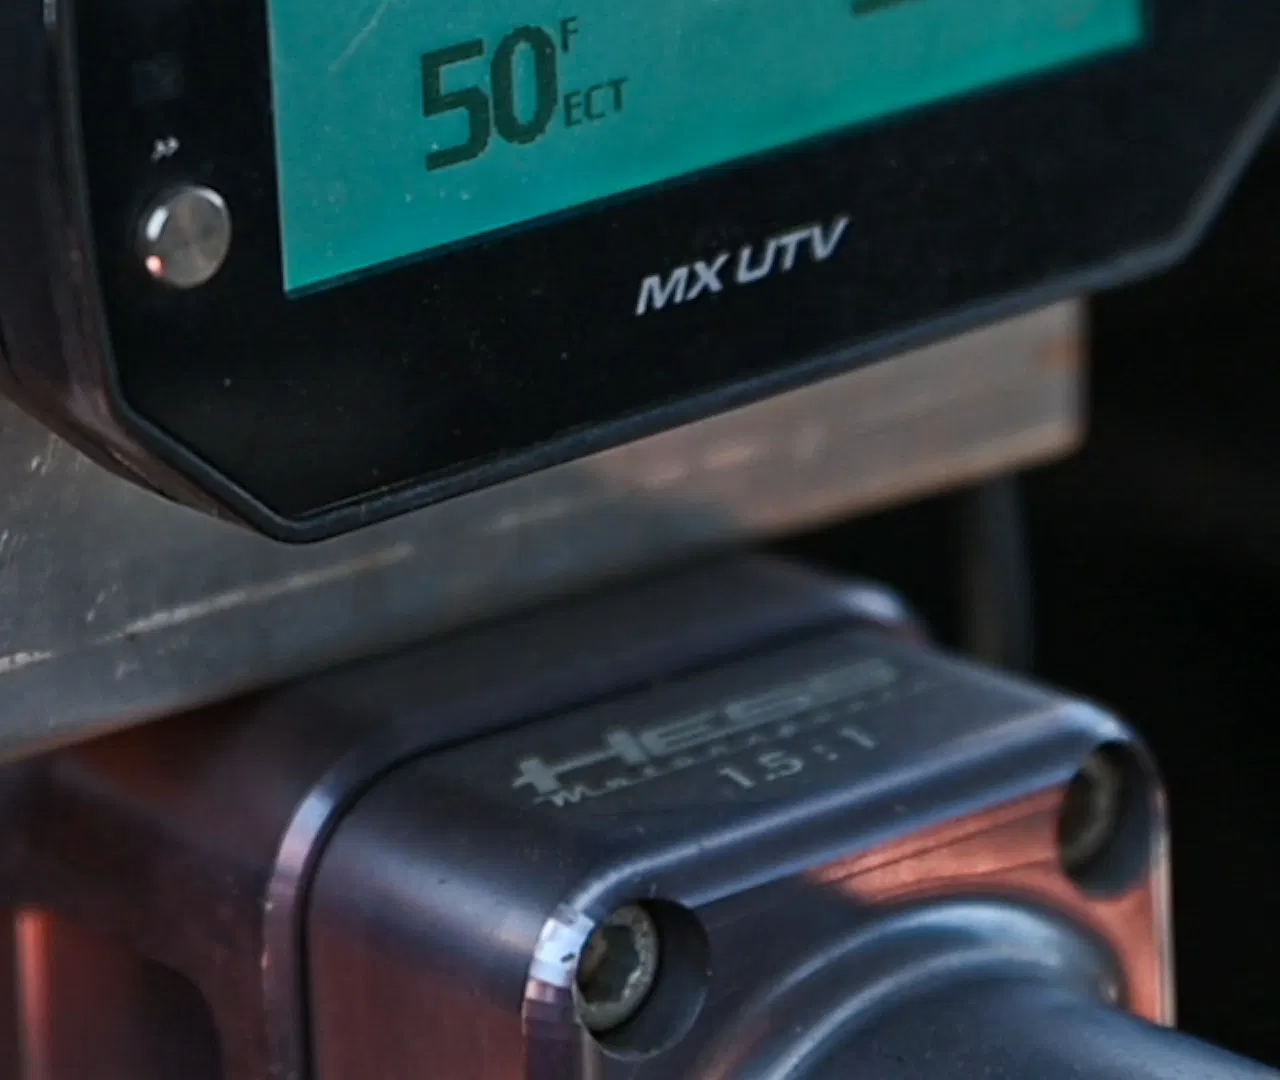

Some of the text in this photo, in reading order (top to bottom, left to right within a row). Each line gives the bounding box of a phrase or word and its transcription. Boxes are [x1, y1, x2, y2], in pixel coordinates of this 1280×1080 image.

[561, 16, 580, 53] F
[421, 24, 558, 172] 50
[564, 77, 630, 128] ECT
[634, 215, 851, 316] MX UTV
